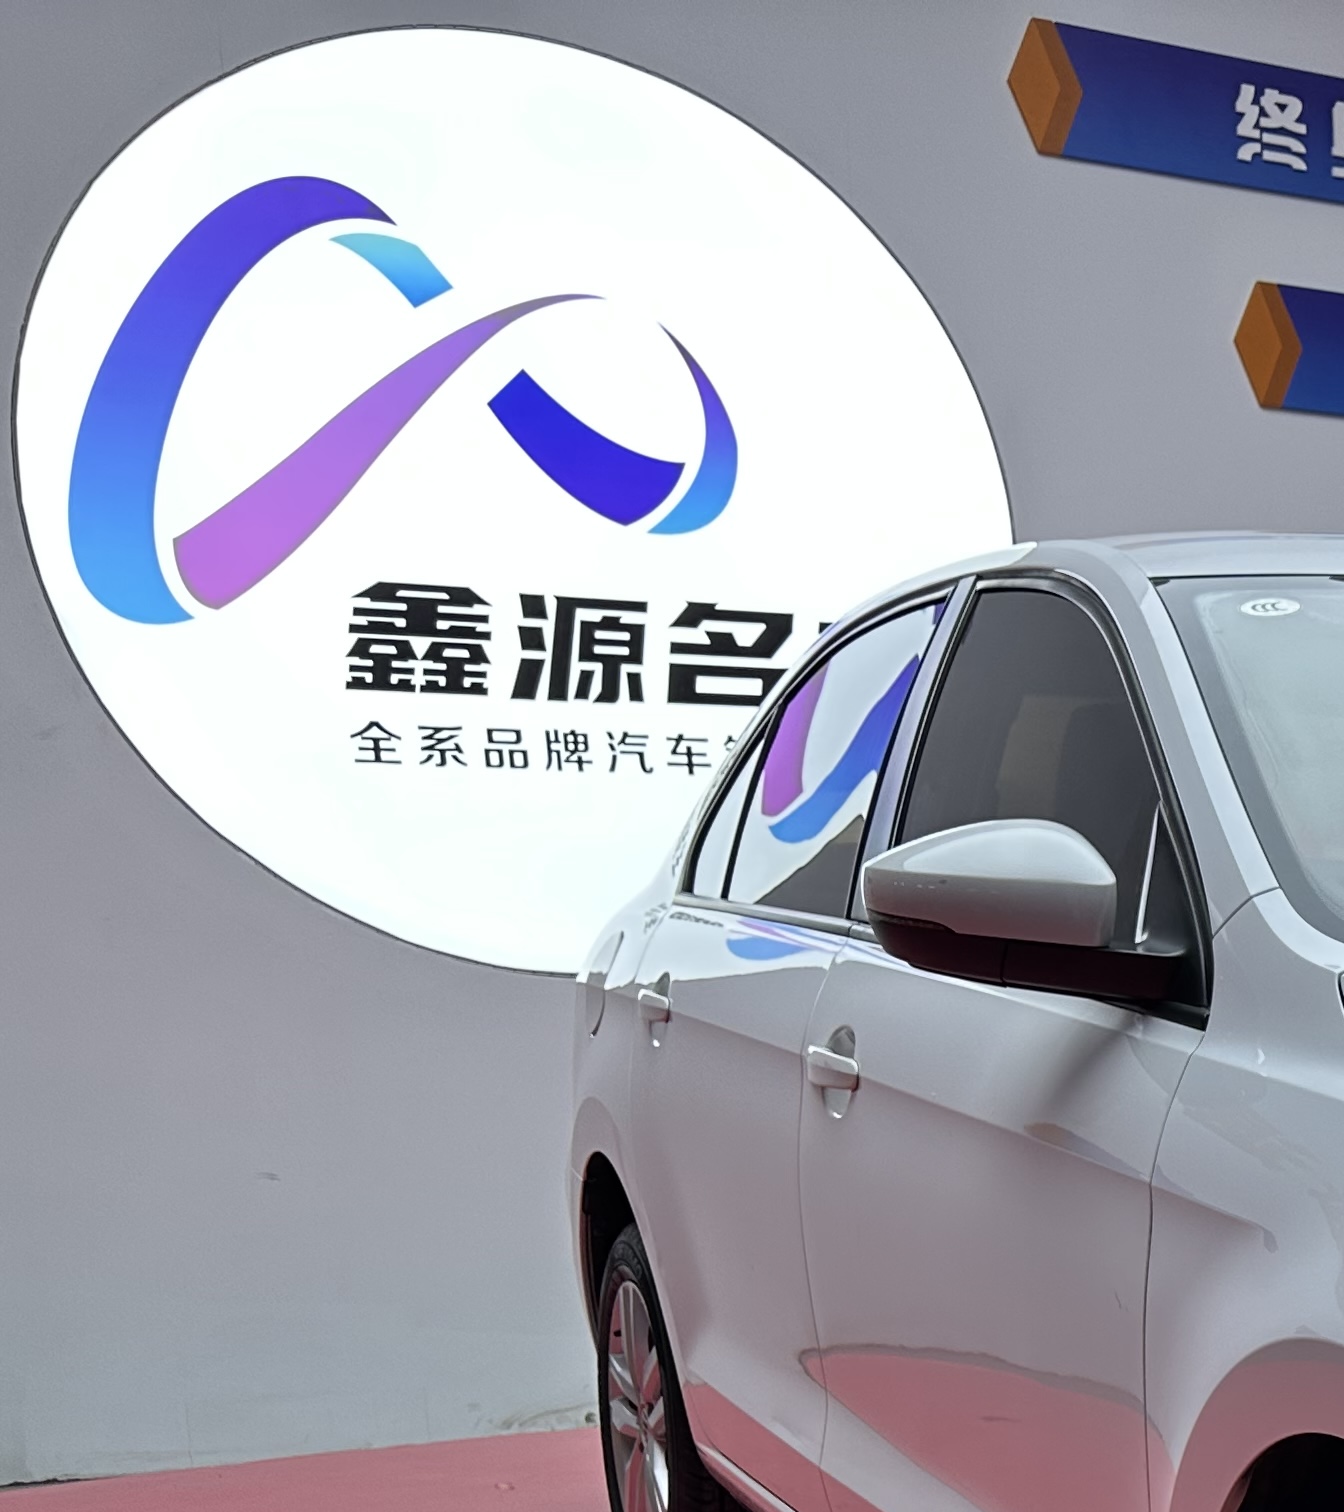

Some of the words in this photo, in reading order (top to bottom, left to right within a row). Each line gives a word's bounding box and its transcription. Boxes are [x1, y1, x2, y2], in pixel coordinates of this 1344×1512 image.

[345, 581, 830, 706] 鑫源名
[350, 720, 745, 775] 全系品牌汽车
